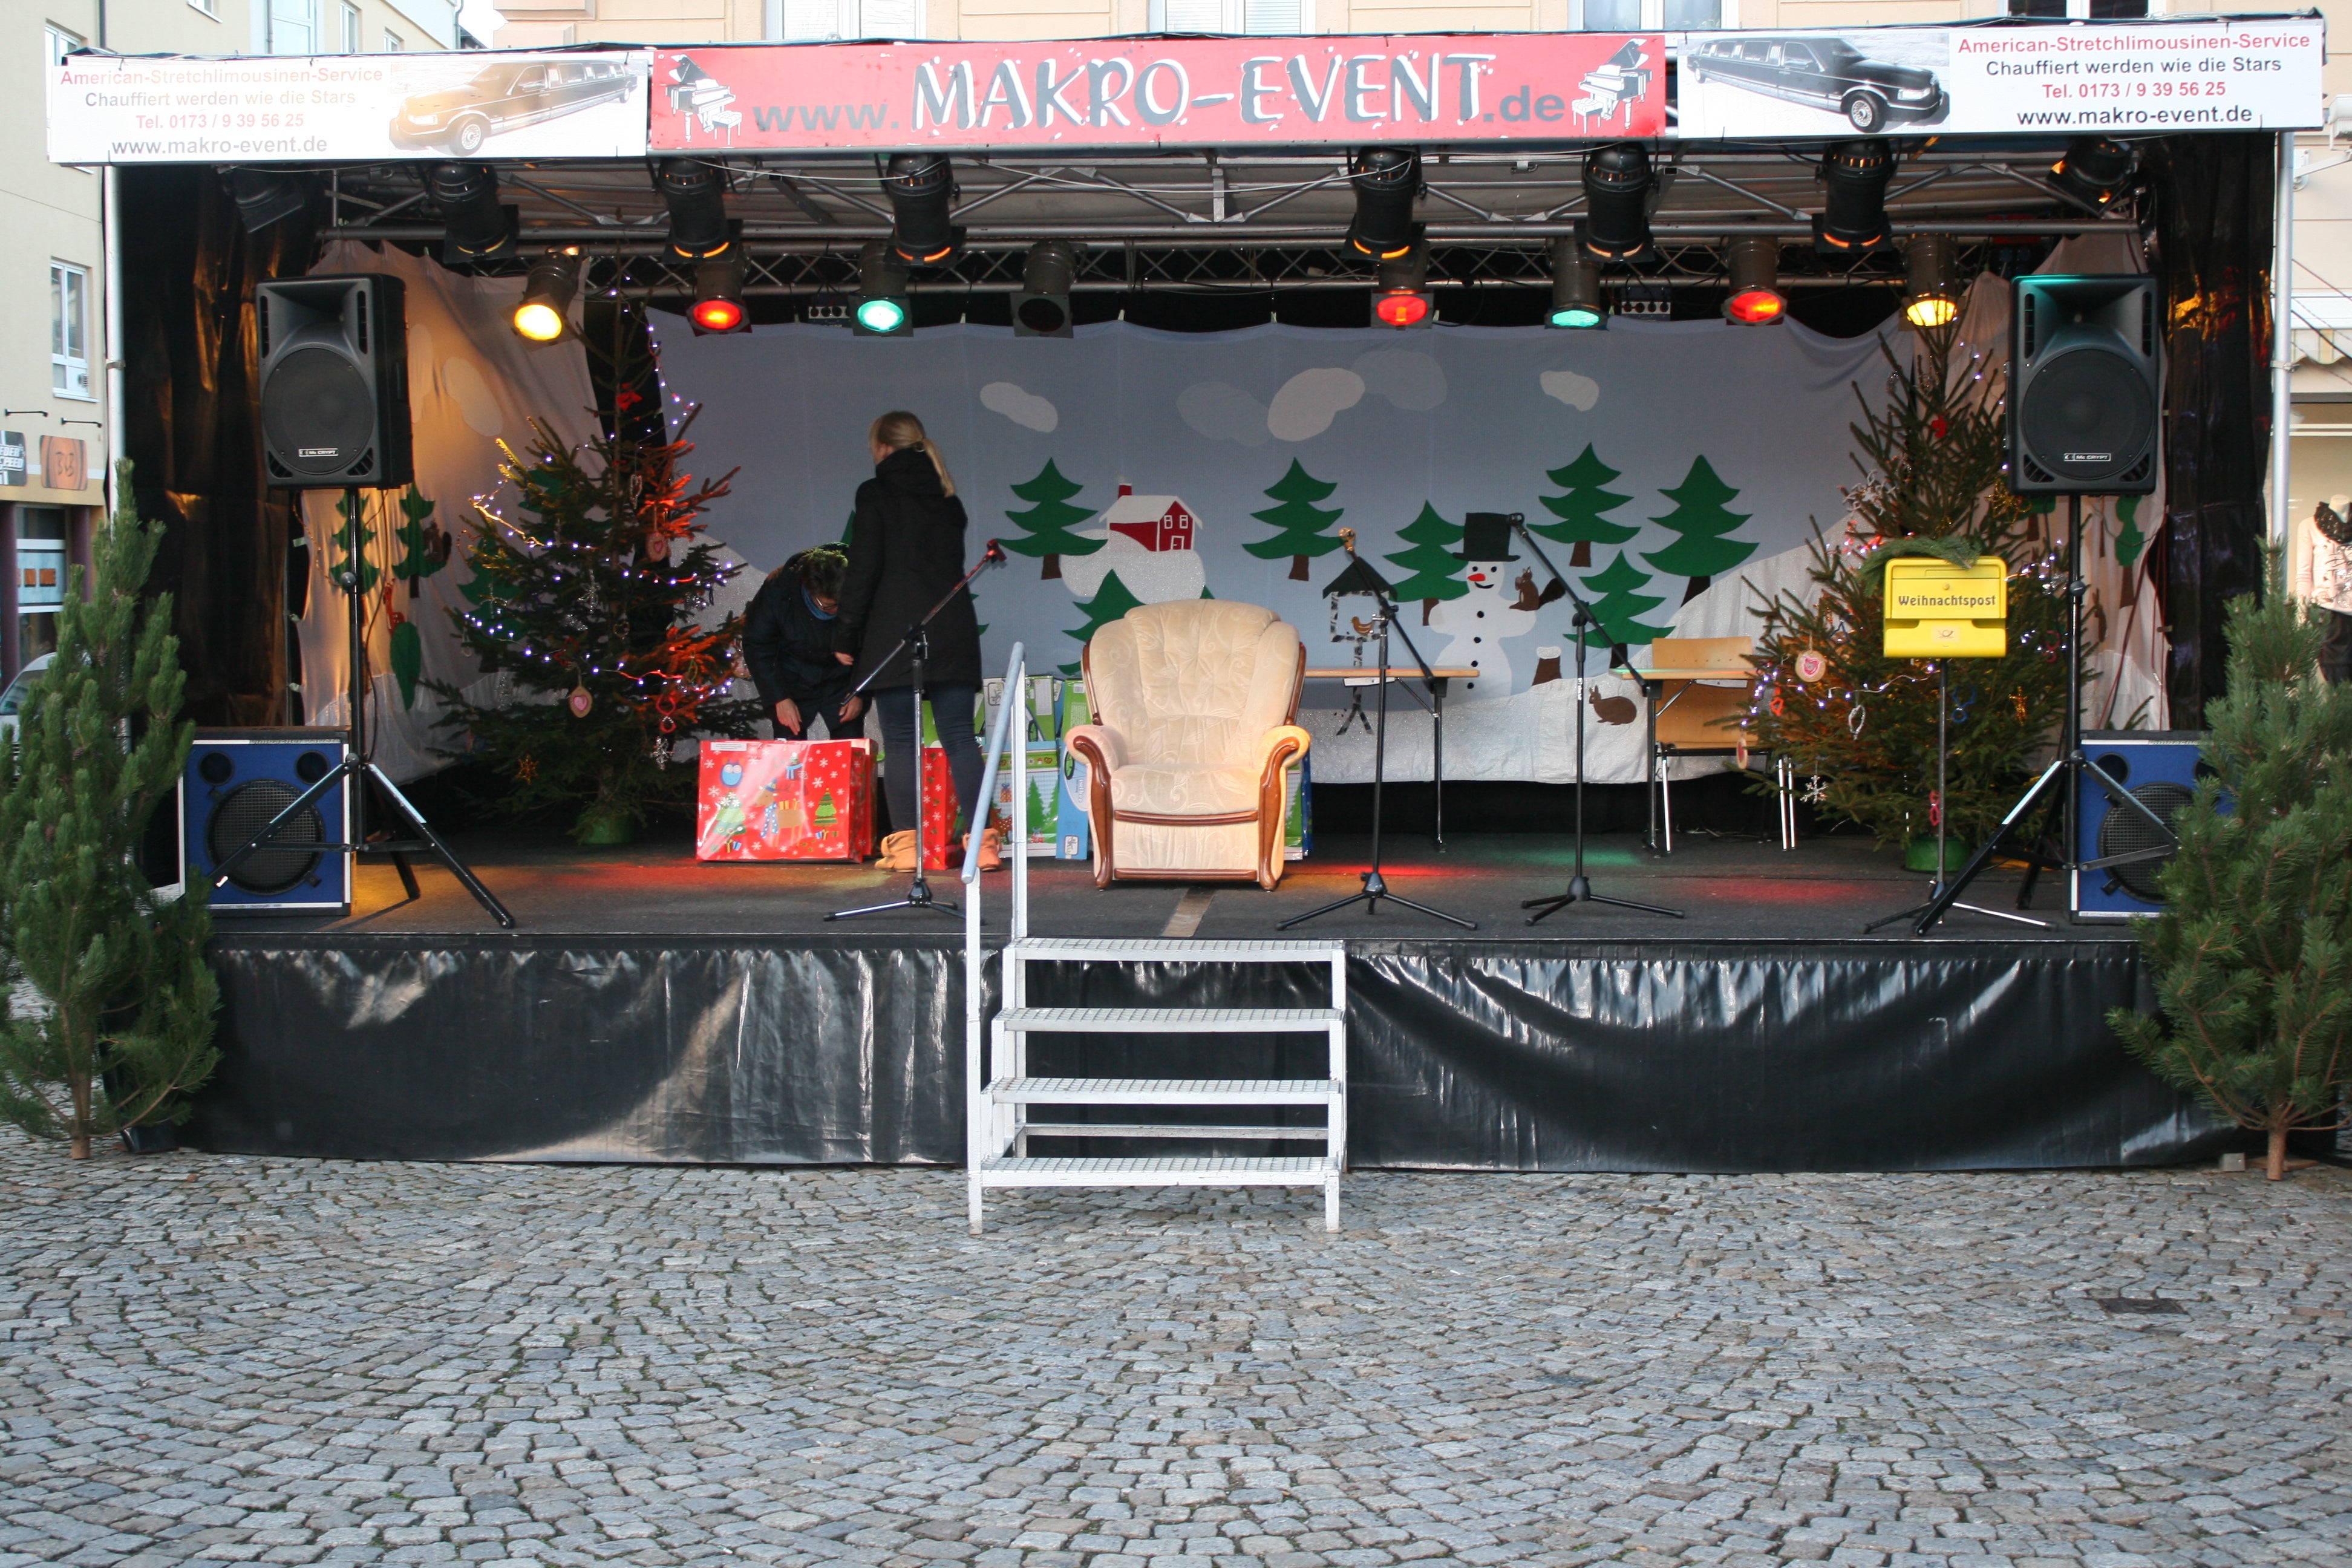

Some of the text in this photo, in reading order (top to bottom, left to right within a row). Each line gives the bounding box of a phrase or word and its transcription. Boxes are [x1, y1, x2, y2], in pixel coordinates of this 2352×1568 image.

[1958, 32, 2310, 53] American-Stretchlimousinen-Service
[1986, 56, 2282, 76] Chauffiert werden wie die Stars
[60, 67, 383, 85] American-Stretchlimousinen-Service
[85, 90, 356, 106] Chauffiert werden wie die Stars
[2042, 83, 2073, 99] Tel.
[2079, 83, 2120, 98] 0173
[2137, 82, 2146, 97] 9
[2152, 82, 2173, 97] 39
[2179, 82, 2199, 96] 56
[2204, 81, 2226, 96] 25
[136, 115, 164, 129] Tel.
[169, 114, 207, 128] 0173
[221, 114, 231, 128] 9
[237, 114, 255, 127] 39
[261, 114, 279, 127] 56
[285, 113, 304, 127] 25
[2017, 105, 2253, 125] www.makro-event.de
[111, 135, 328, 154] www.makro-event.de
[1898, 595, 1996, 607] Weihnachtspost
